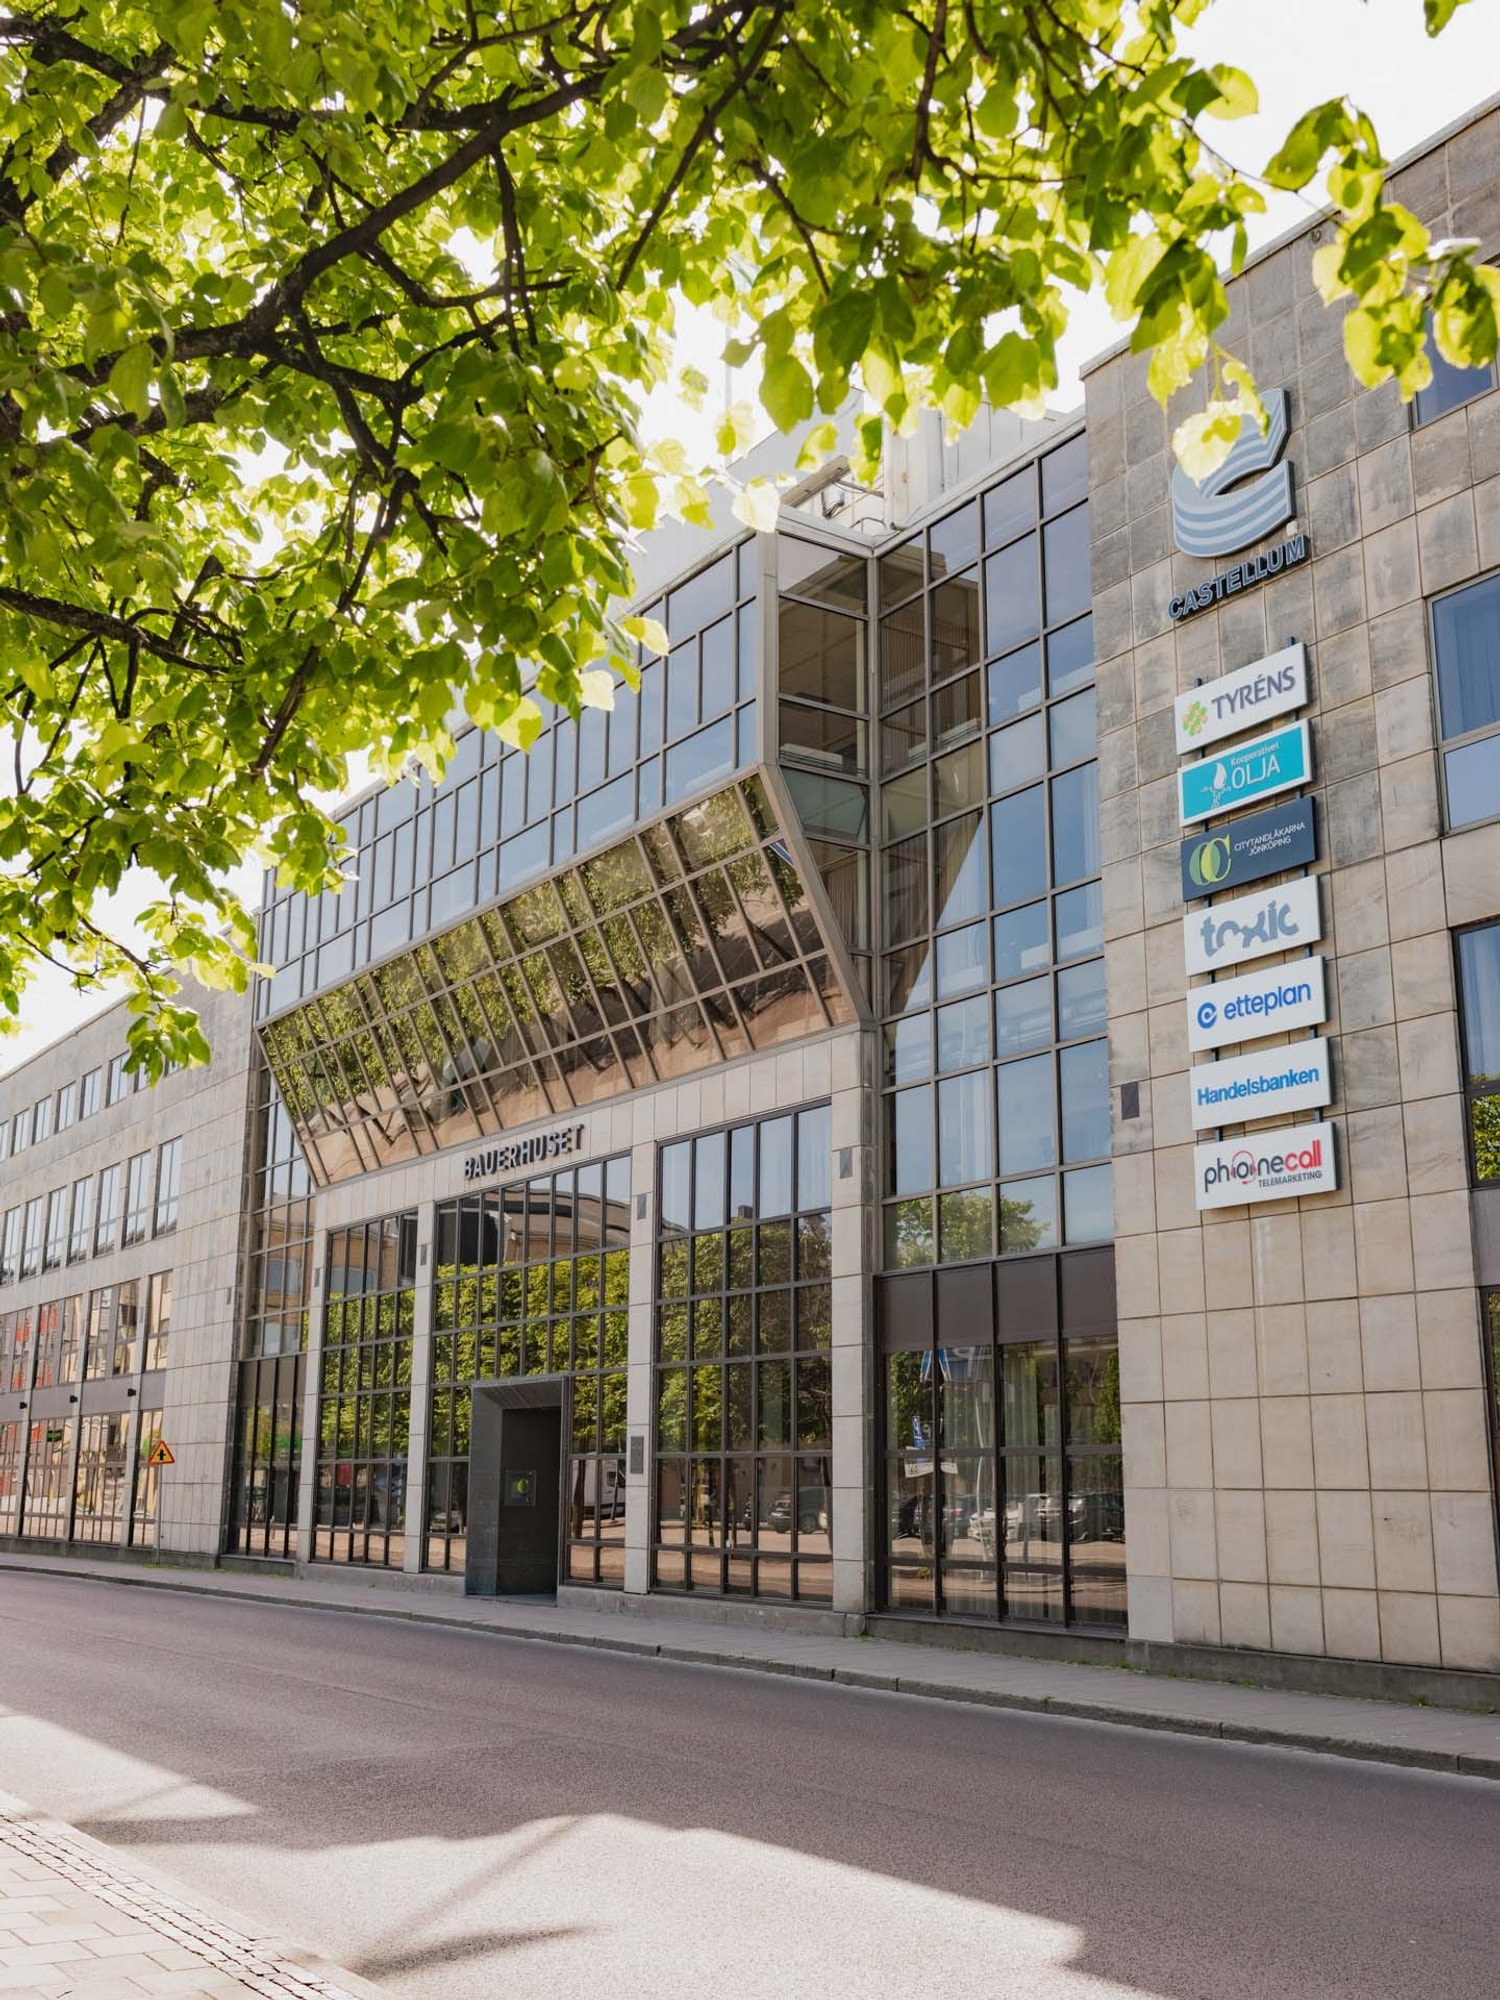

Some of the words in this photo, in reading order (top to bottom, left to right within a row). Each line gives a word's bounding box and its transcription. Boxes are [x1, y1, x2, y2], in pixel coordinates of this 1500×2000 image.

[1168, 534, 1308, 620] CASTELLUM
[1211, 666, 1296, 719] TYRÉNS
[1231, 754, 1281, 789] OLJA
[1200, 900, 1299, 958] toxic
[1223, 983, 1312, 1020] etteplan
[1197, 1067, 1320, 1106] Handelsbanken
[464, 1123, 585, 1180] BAUERHUSET
[1204, 1139, 1322, 1193] phonecall
[1258, 1170, 1323, 1188] TELEMARKETING
